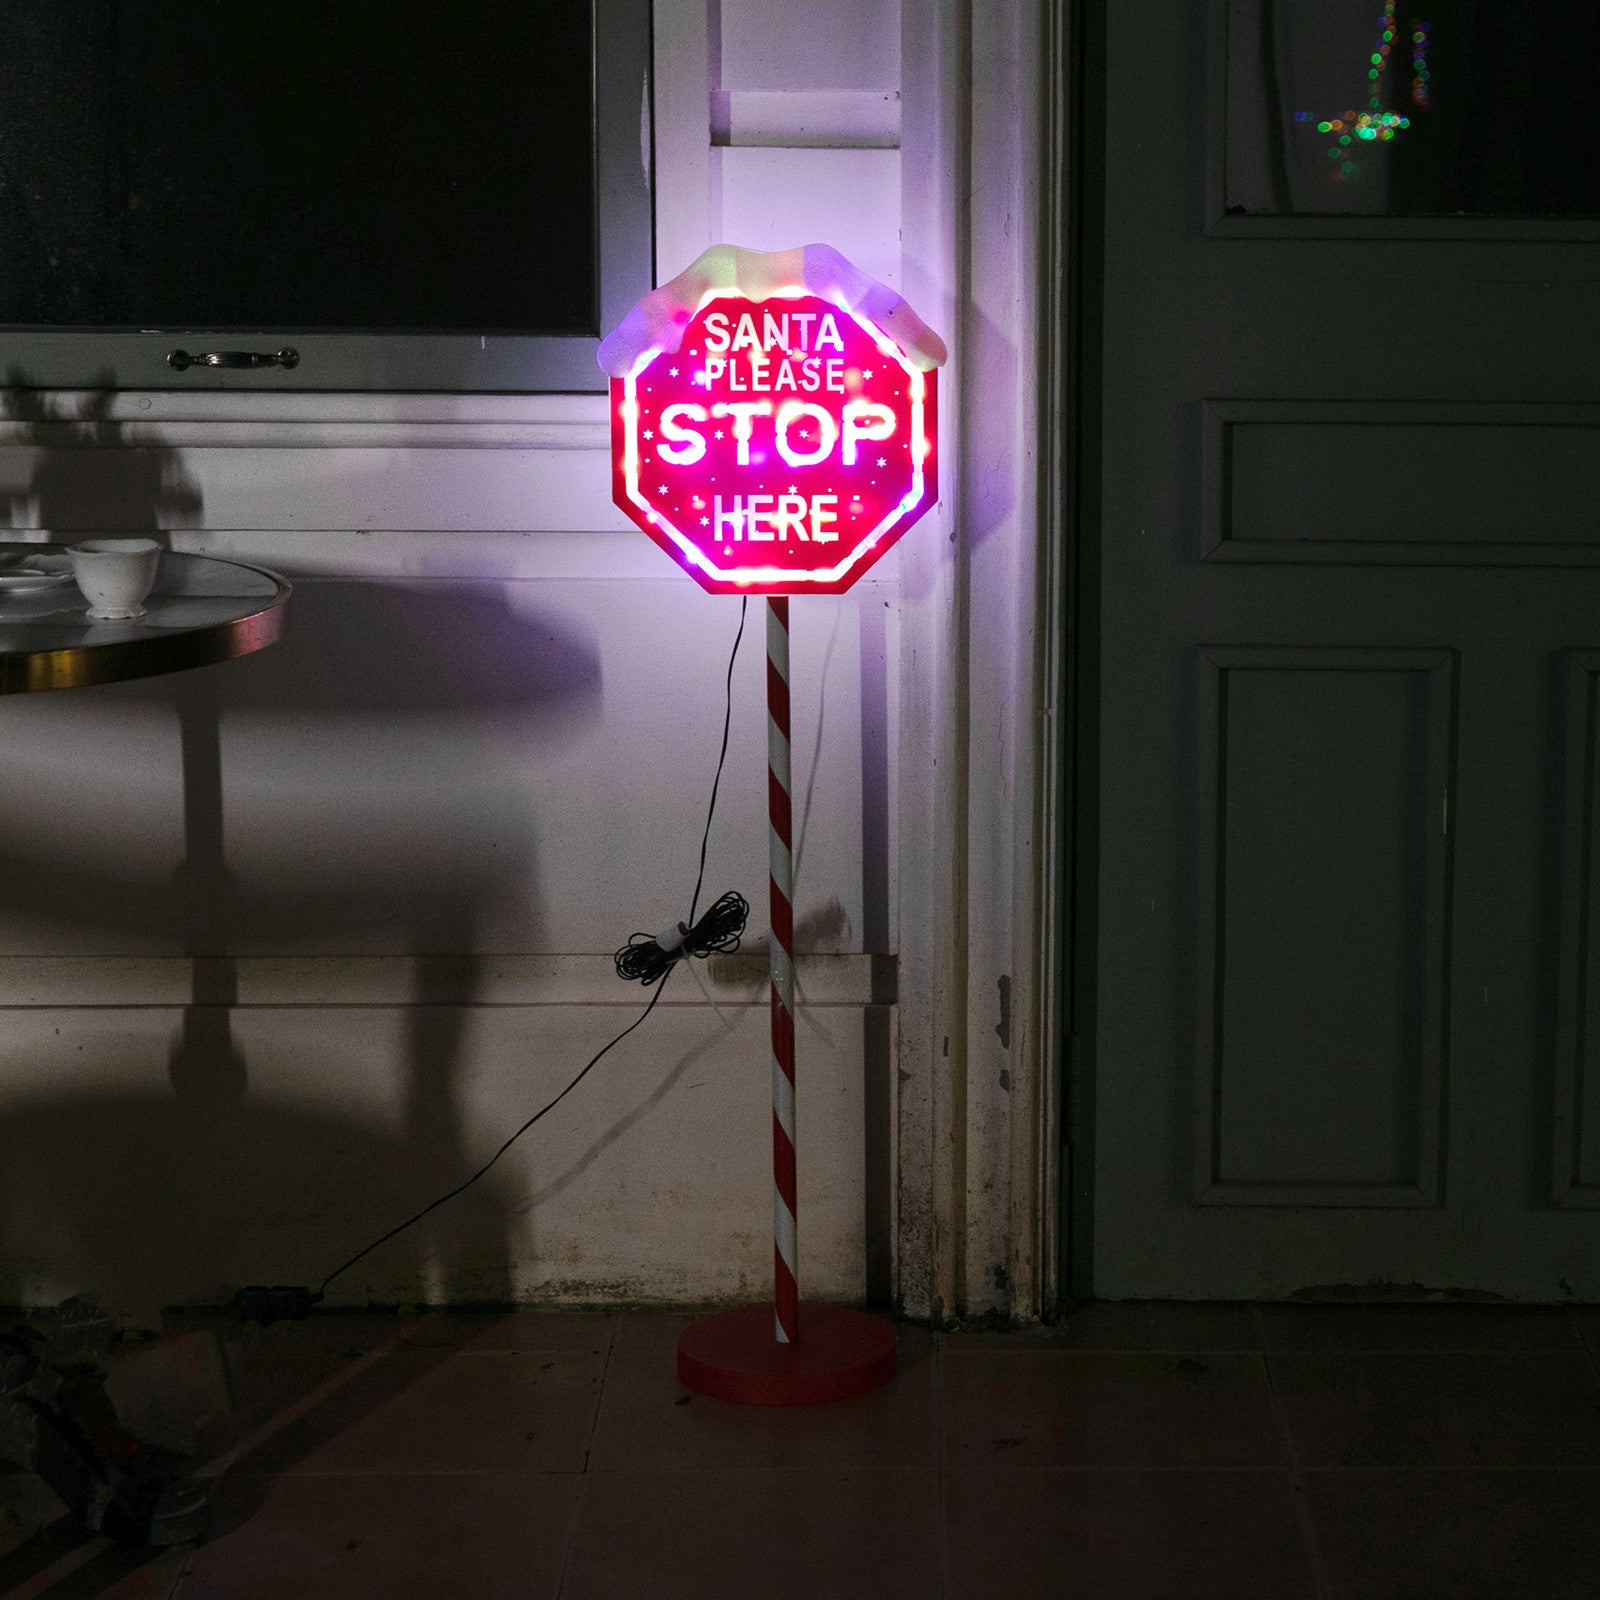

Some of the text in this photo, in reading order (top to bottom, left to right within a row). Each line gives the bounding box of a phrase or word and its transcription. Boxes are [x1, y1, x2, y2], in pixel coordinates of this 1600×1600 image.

[704, 312, 844, 352] SANTA
[705, 358, 845, 392] PLEASE
[657, 402, 896, 466] STOP
[714, 494, 839, 541] HERE
